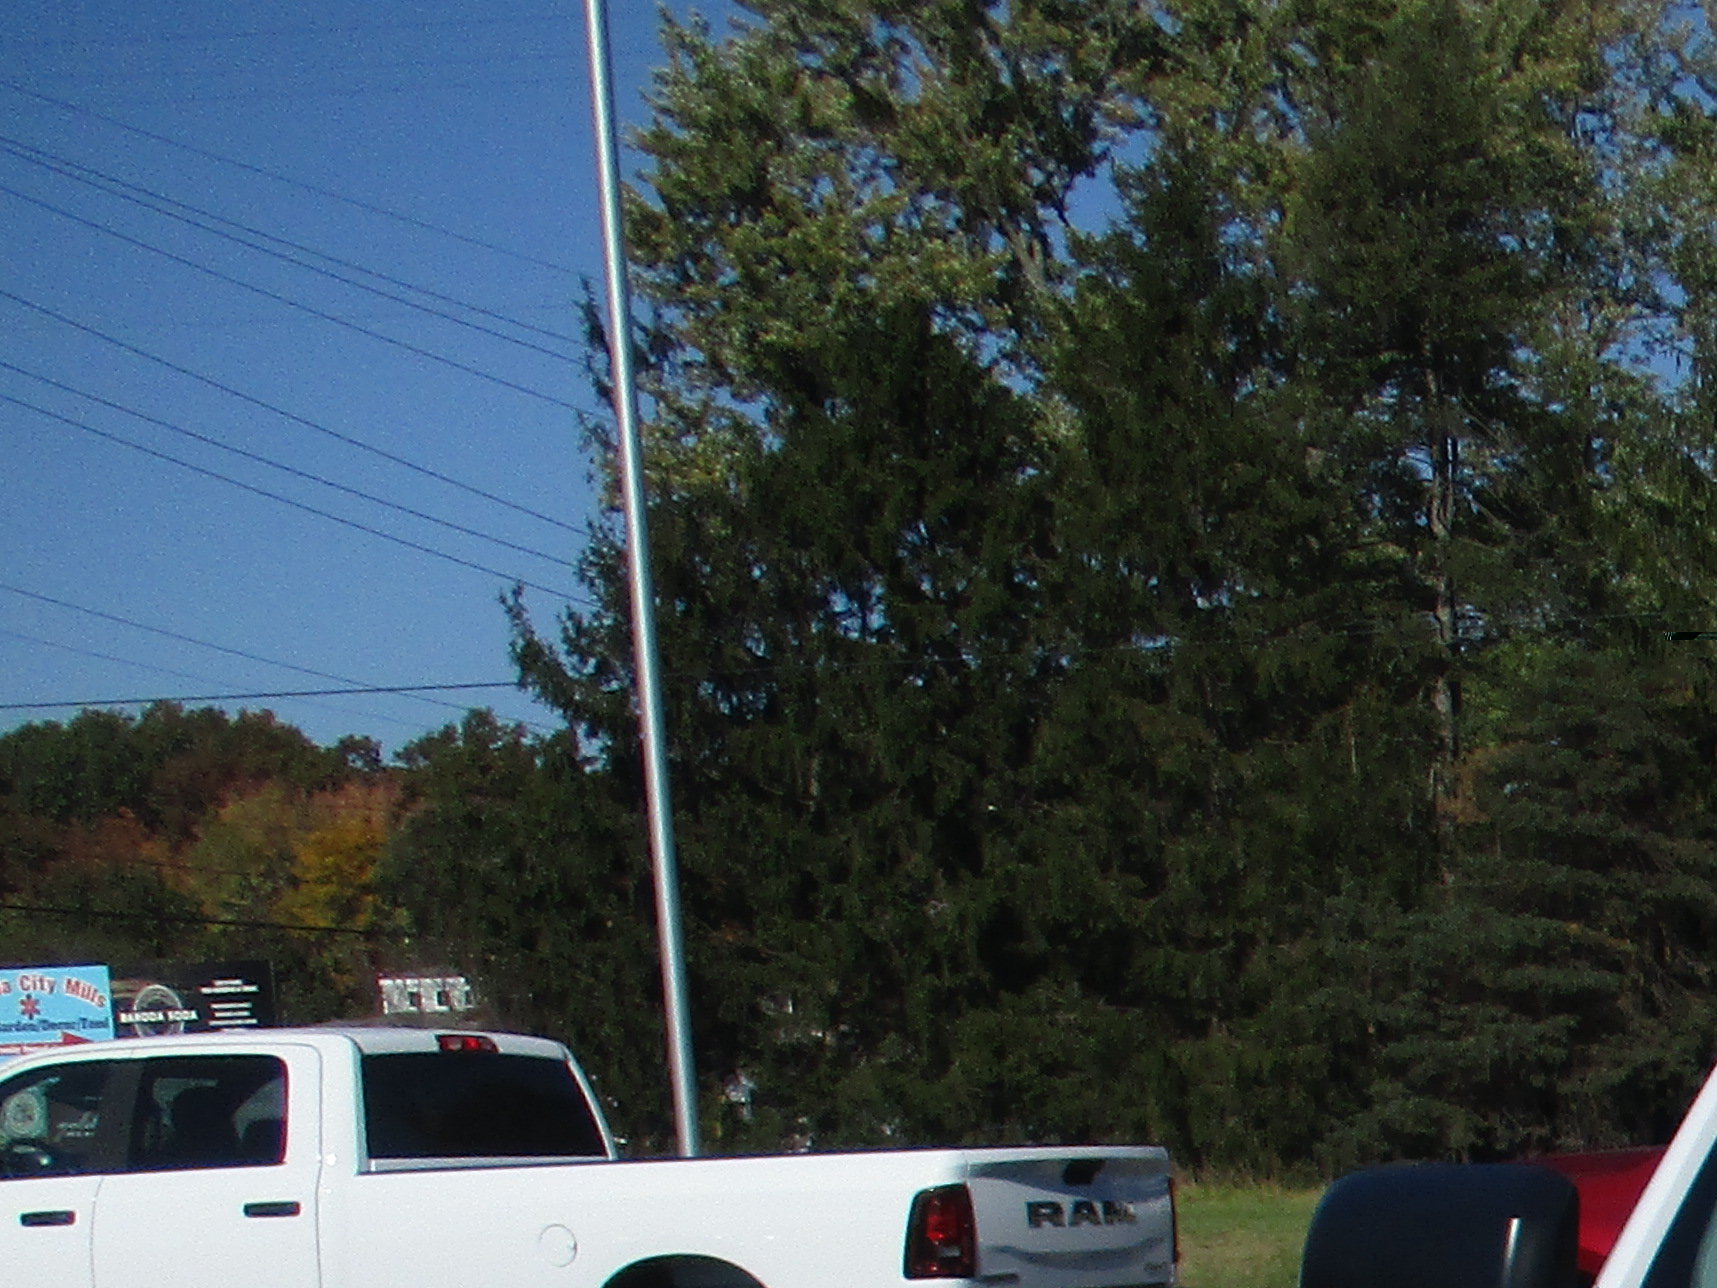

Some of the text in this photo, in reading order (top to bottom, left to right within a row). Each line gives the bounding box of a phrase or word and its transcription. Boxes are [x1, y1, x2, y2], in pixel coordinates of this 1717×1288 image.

[20, 974, 56, 995] City
[65, 977, 107, 1008] Mills
[1026, 1201, 1137, 1228] RAM
